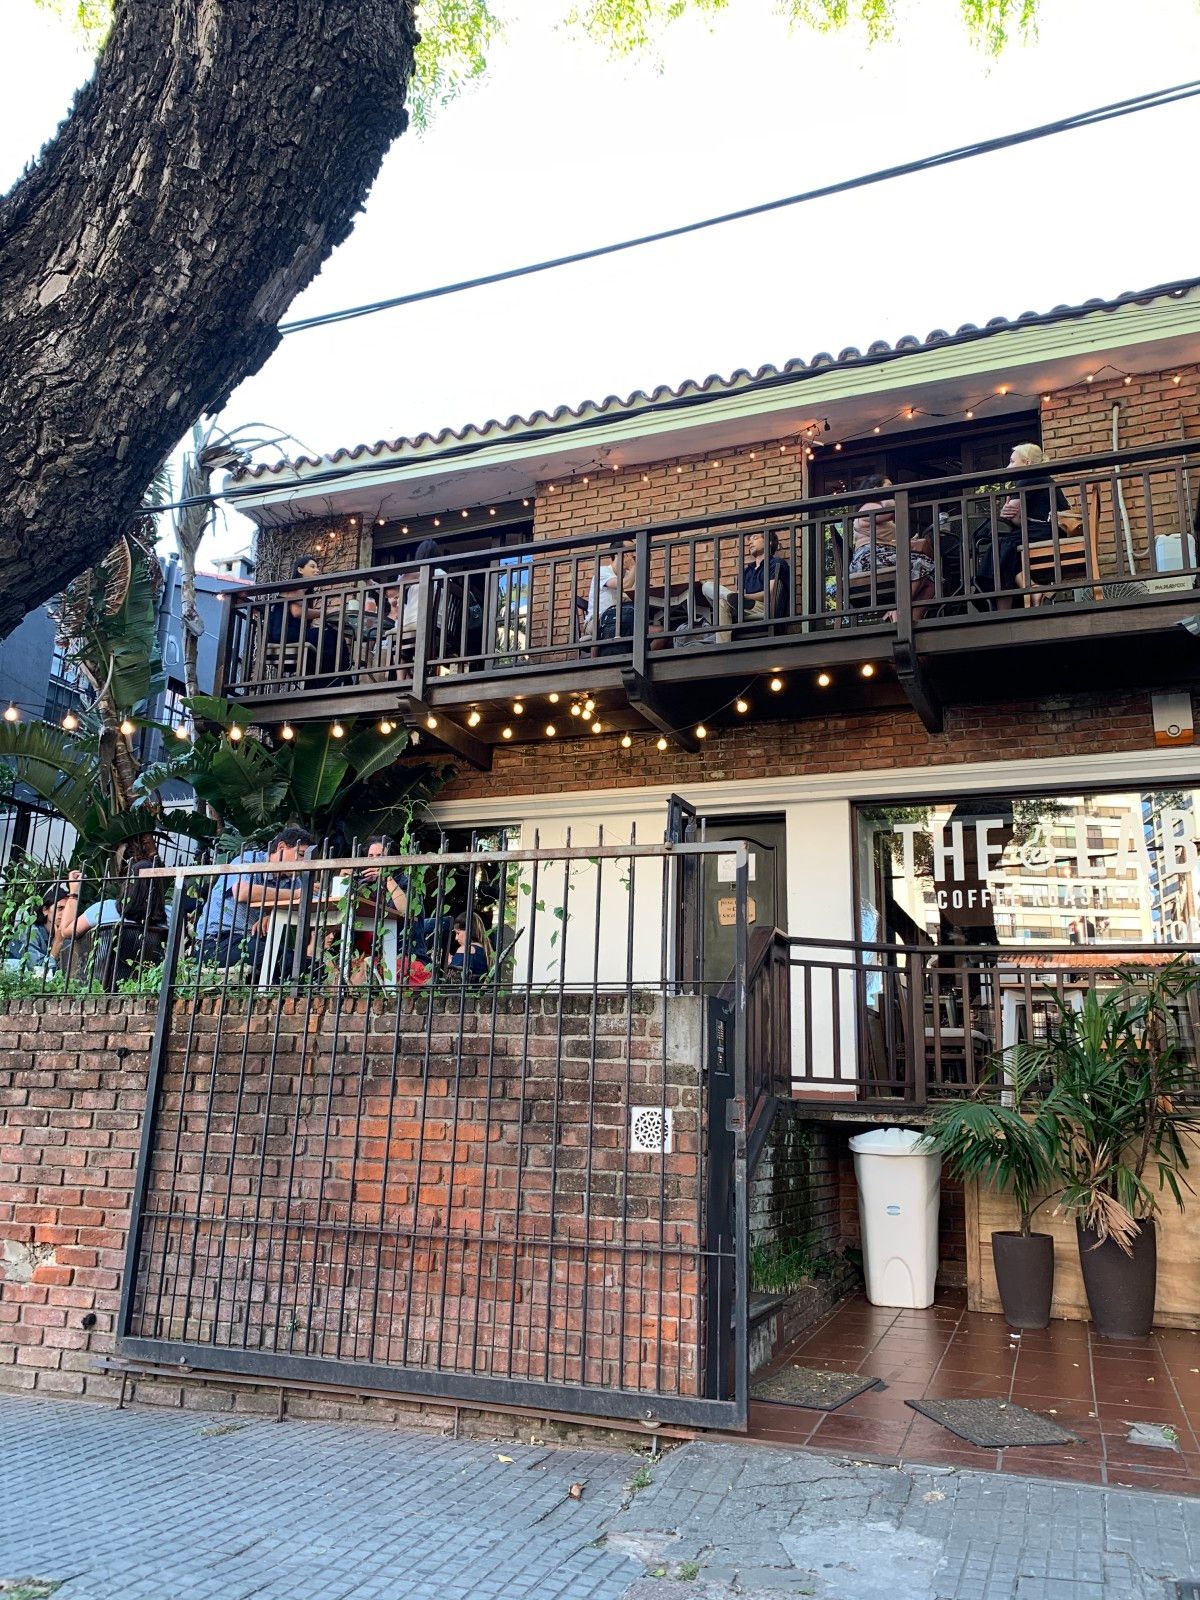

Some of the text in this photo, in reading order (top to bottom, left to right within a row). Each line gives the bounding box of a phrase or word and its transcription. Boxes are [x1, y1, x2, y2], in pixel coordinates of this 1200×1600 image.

[893, 809, 1197, 883] THE LAB
[937, 886, 1019, 909] COFFEE
